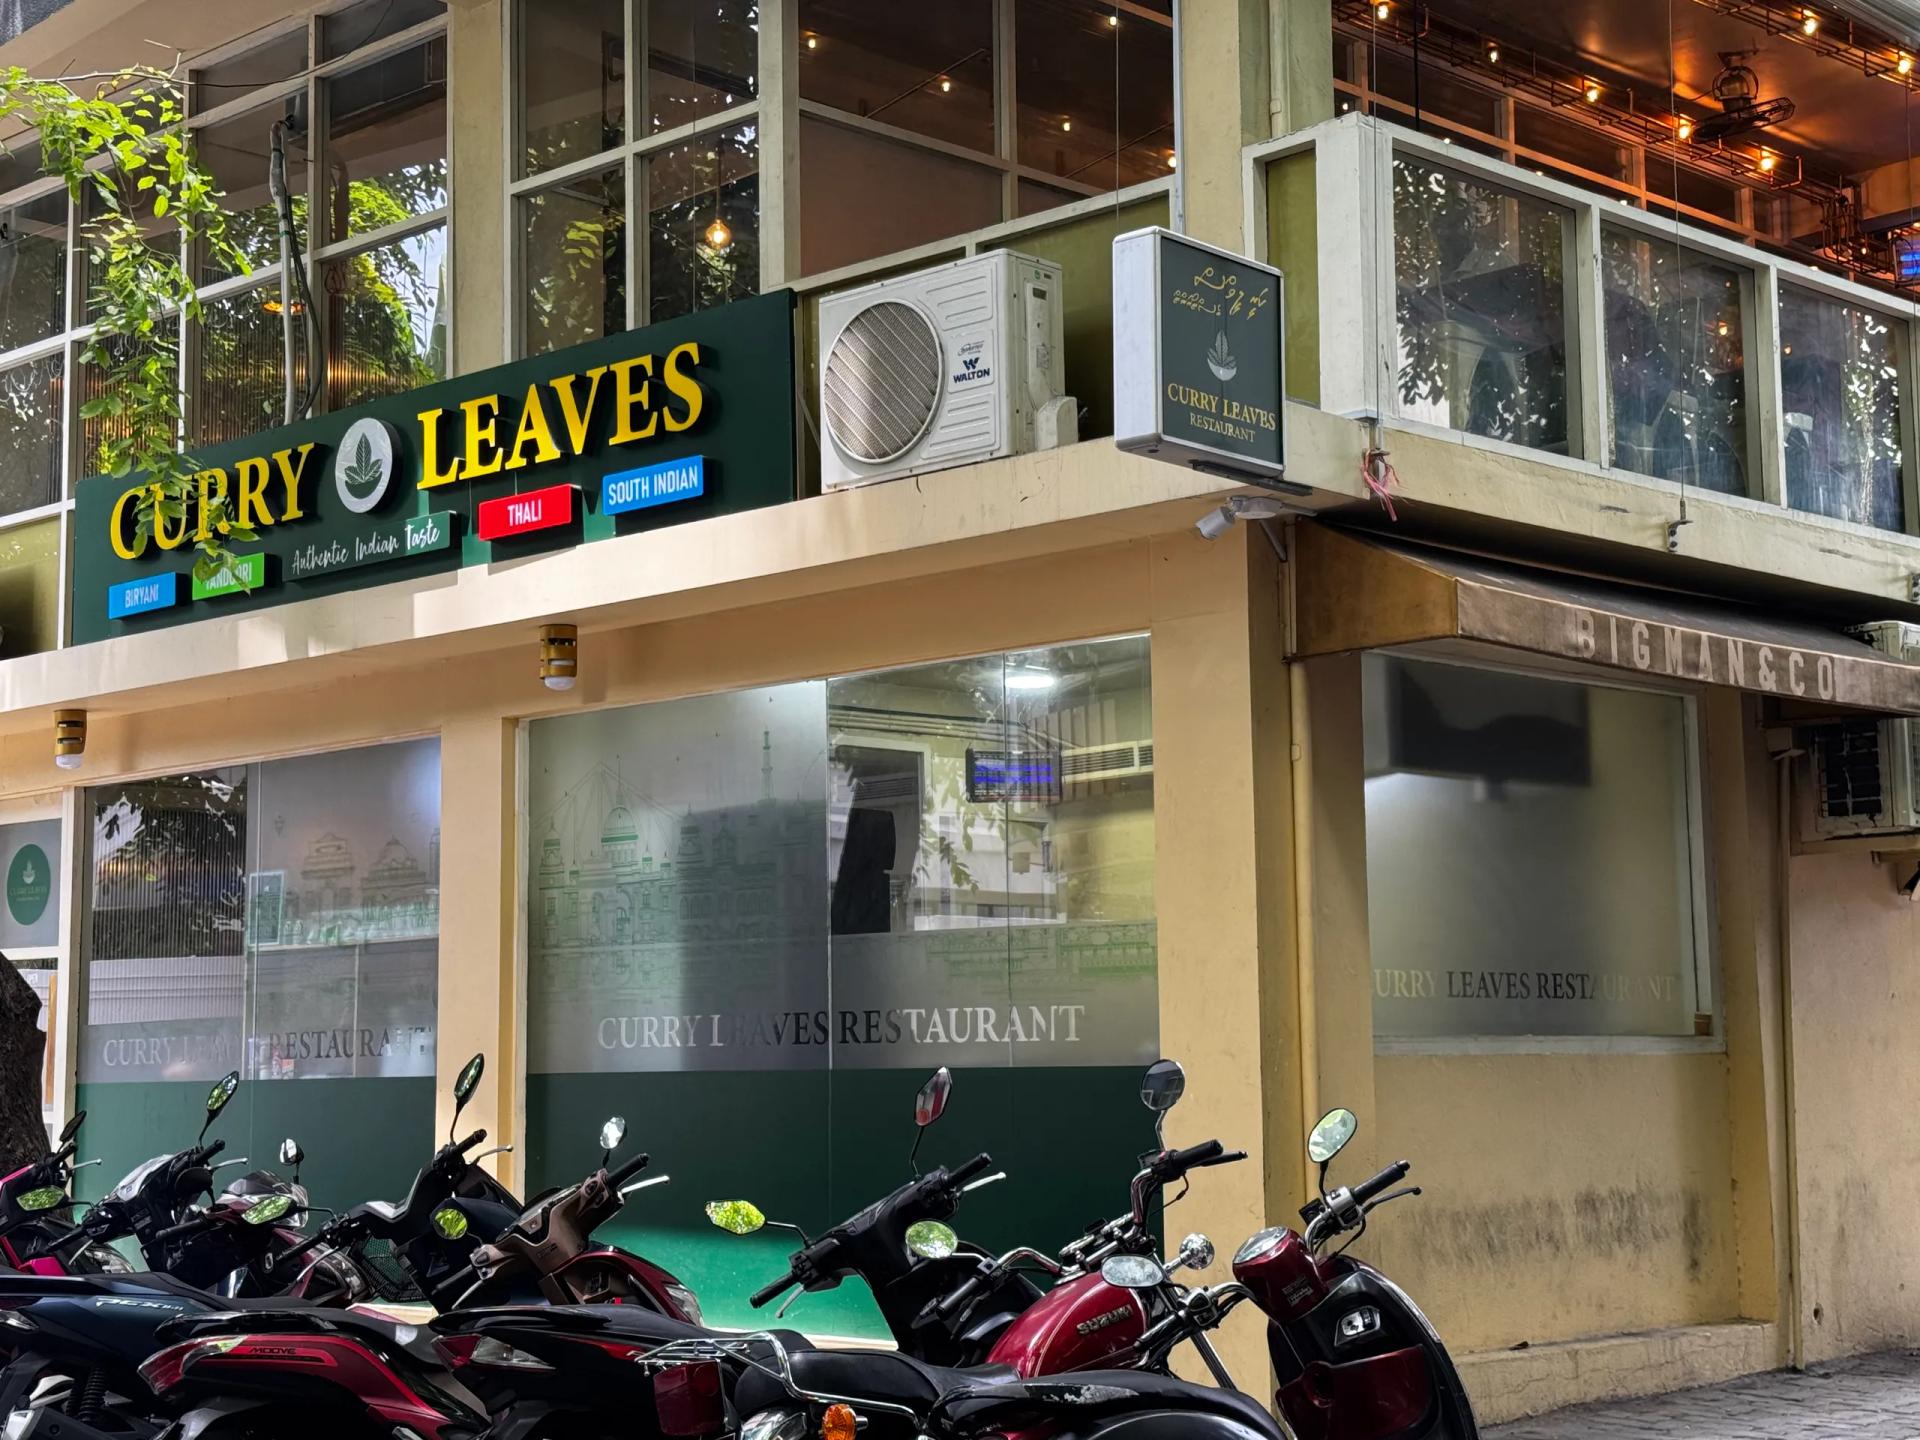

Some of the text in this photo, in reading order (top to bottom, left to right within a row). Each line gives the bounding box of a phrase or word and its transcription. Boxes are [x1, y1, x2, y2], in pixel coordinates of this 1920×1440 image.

[952, 367, 991, 384] WALTON
[1167, 382, 1277, 432] CURRY LEAVES
[1189, 412, 1256, 443] RESTAURANT
[109, 342, 704, 560] CURRY LEAVES
[608, 465, 699, 506] SOUTH INDIAN
[507, 498, 542, 527] THALI
[291, 518, 441, 576] Authentic Indian Taste
[125, 583, 159, 609] BIRYANI
[1371, 967, 1677, 1003] URRY LEAVES RESTURNT
[599, 1004, 1086, 1050] CURRY LEAVES RESTAURANT
[102, 1036, 176, 1067] CURRY
[268, 1027, 433, 1061] RESTAURA
[1076, 1303, 1134, 1335] SUZUKI
